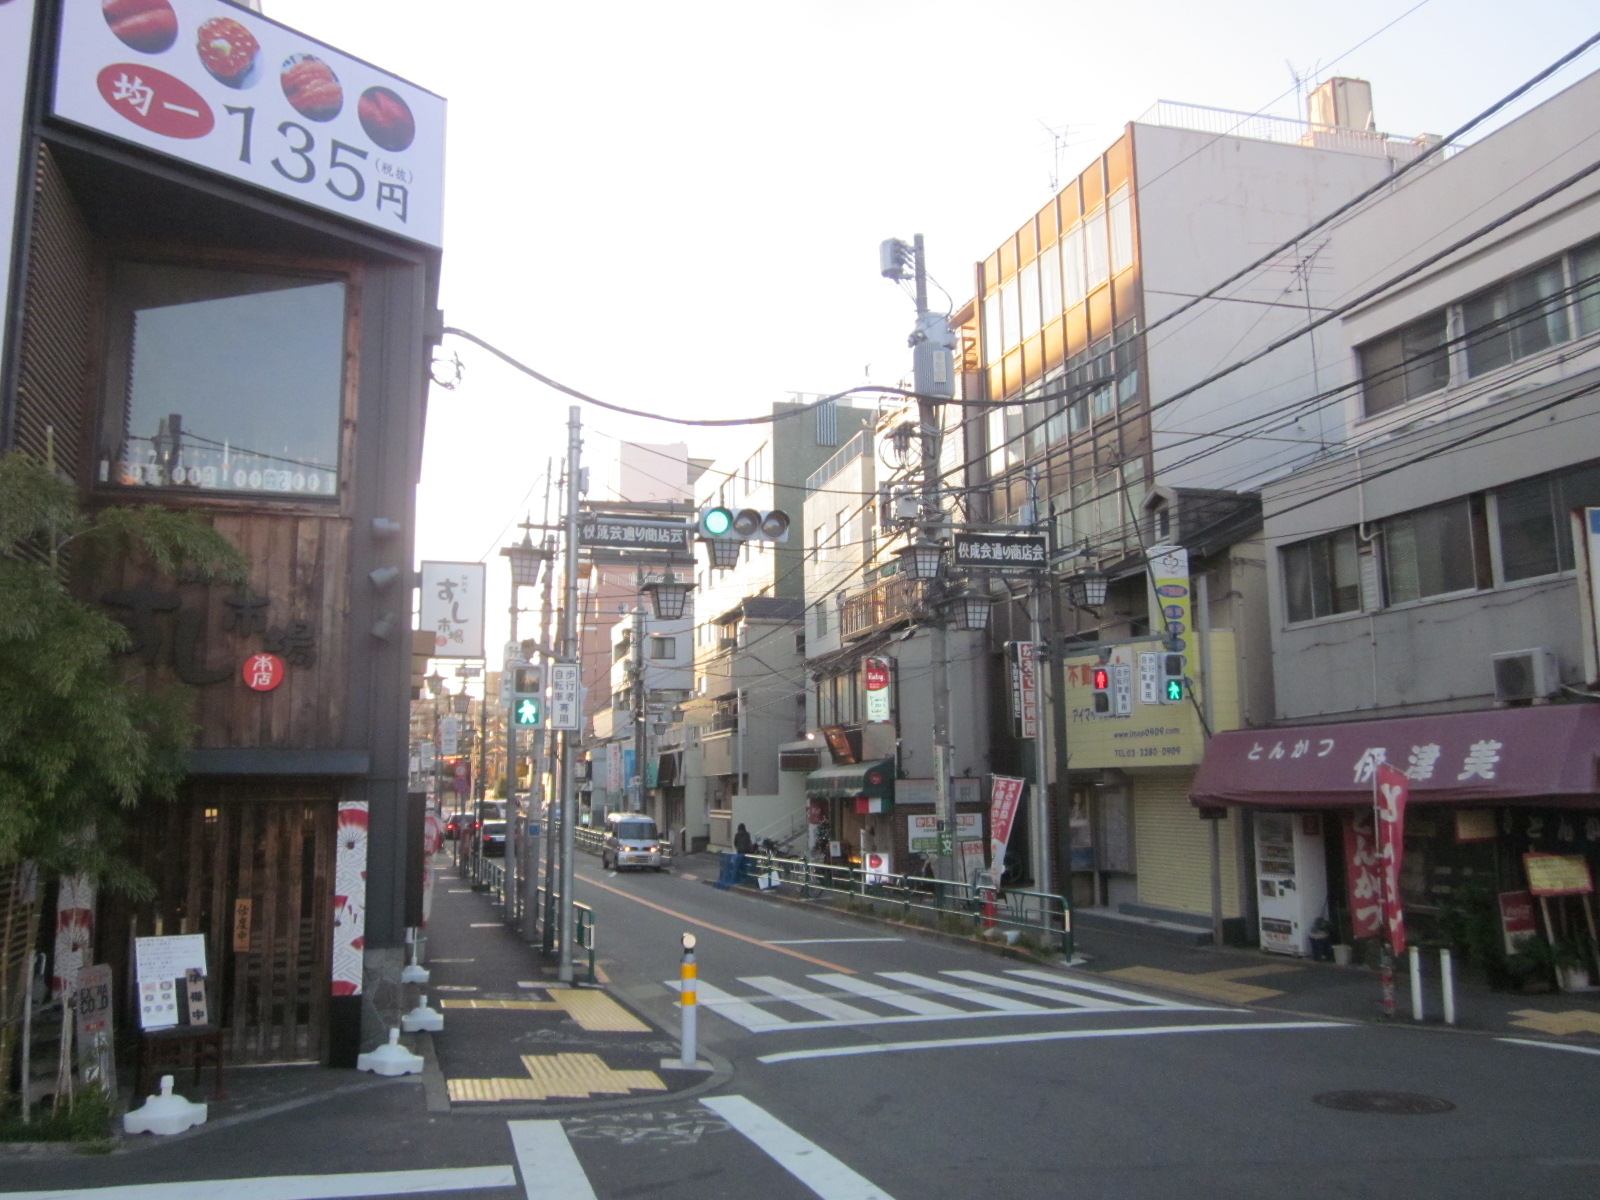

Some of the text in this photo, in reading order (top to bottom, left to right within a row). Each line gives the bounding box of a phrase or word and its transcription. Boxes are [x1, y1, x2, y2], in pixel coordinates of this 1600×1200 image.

[112, 72, 201, 118] 均一
[251, 655, 273, 687] 本店
[554, 670, 564, 702] 自転車
[565, 670, 575, 702] 歩行者
[559, 703, 569, 724] 専用
[1246, 738, 1504, 784] とんかつ 伊津美
[80, 985, 108, 1000] EXRA
